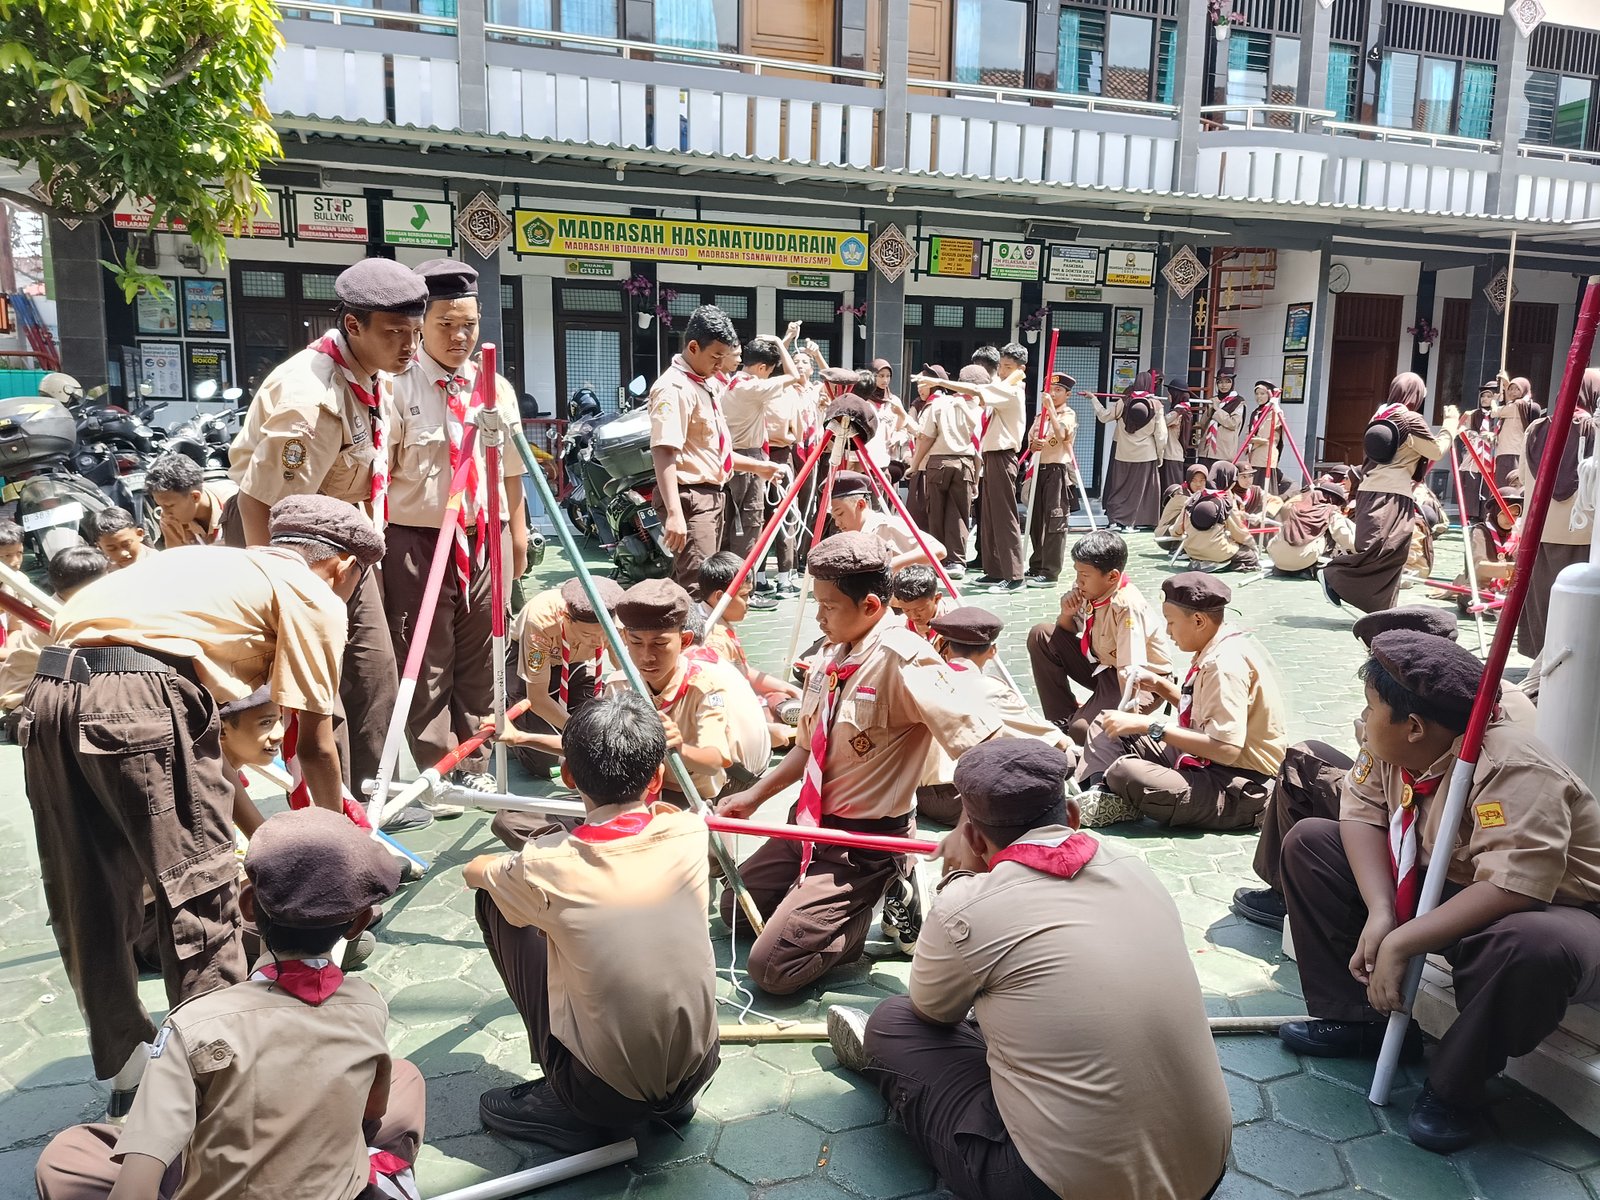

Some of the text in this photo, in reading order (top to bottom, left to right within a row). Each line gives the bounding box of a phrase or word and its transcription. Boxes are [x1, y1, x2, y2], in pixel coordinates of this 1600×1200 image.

[314, 212, 353, 222] BULLYING
[558, 218, 837, 254] MADRASAH HASANATUDDARAIN
[564, 241, 832, 266] MADRASAH IBTIDAIYAH (MI/SD) MADRASAH TSANAWIYAH (MTs/SMP)
[580, 267, 612, 275] GURU
